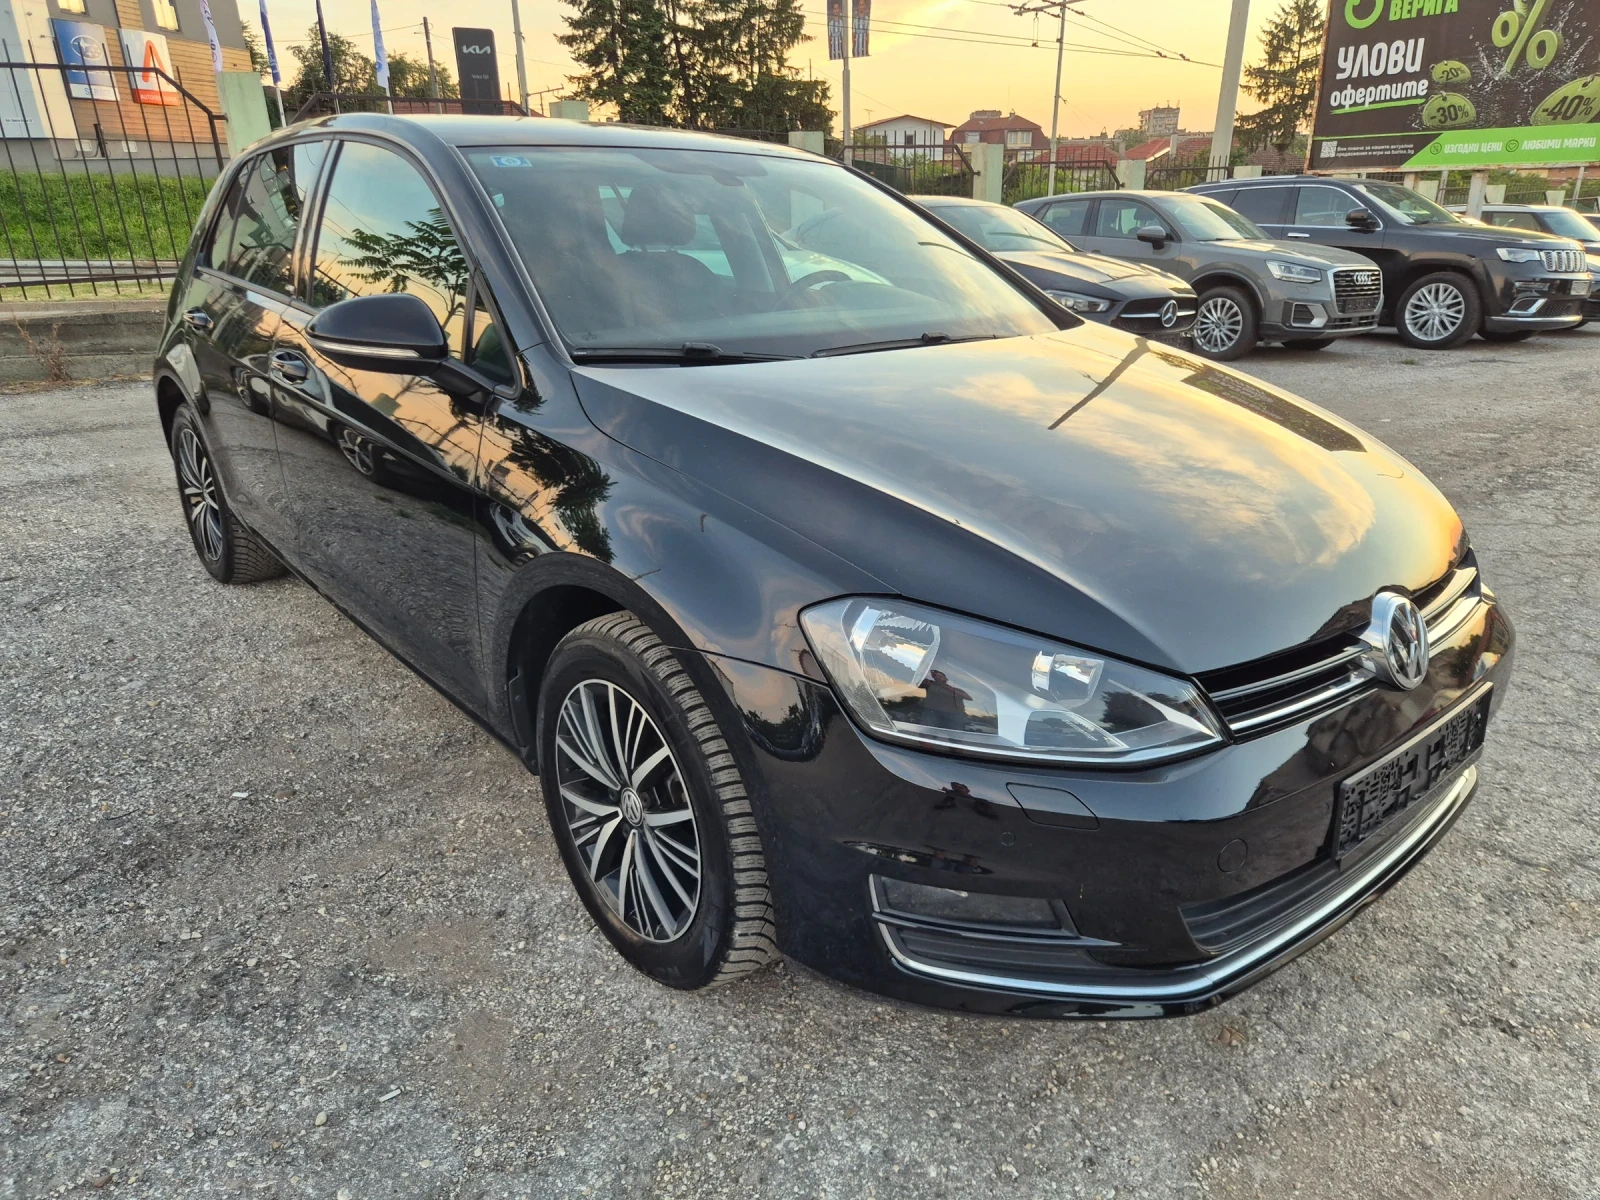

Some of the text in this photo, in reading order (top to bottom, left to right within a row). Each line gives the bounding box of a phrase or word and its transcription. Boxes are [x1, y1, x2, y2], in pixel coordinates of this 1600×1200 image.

[1335, 38, 1425, 80] УЛОВИ
[84, 87, 113, 98] SRVICE
[1330, 79, 1429, 110] офертите
[1430, 104, 1469, 124] -30%
[1541, 95, 1597, 121] -40%
[1444, 141, 1503, 154] ИЗГОДНИ ЦЕНИ
[1521, 137, 1597, 150] ЛЮБИМИ МАРКИ
